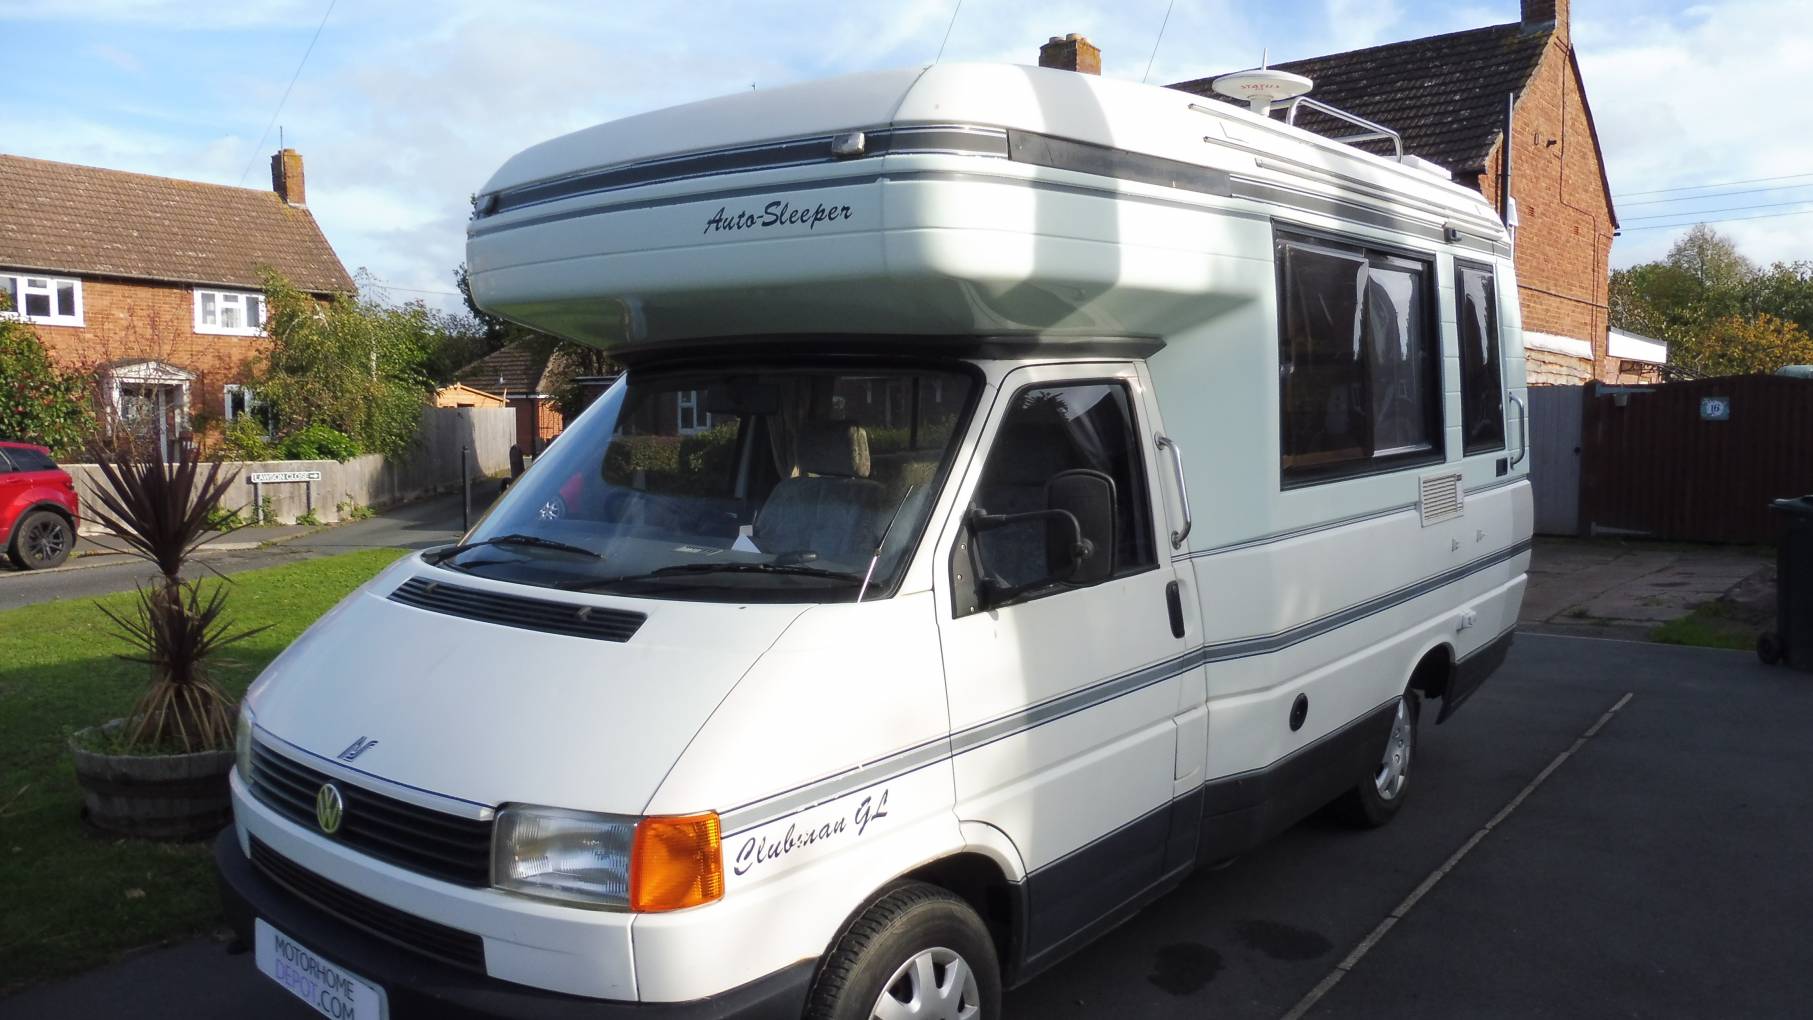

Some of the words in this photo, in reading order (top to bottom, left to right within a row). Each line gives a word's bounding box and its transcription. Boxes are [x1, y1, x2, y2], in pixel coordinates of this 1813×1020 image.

[703, 200, 853, 235] Auto-Sleeper
[1711, 403, 1720, 412] 16
[254, 472, 285, 481] LAWSON
[286, 471, 309, 480] CLOSE
[854, 788, 889, 836] GL
[275, 934, 355, 1002] MOTORHOME
[275, 958, 355, 1020] DEPOT.COM
